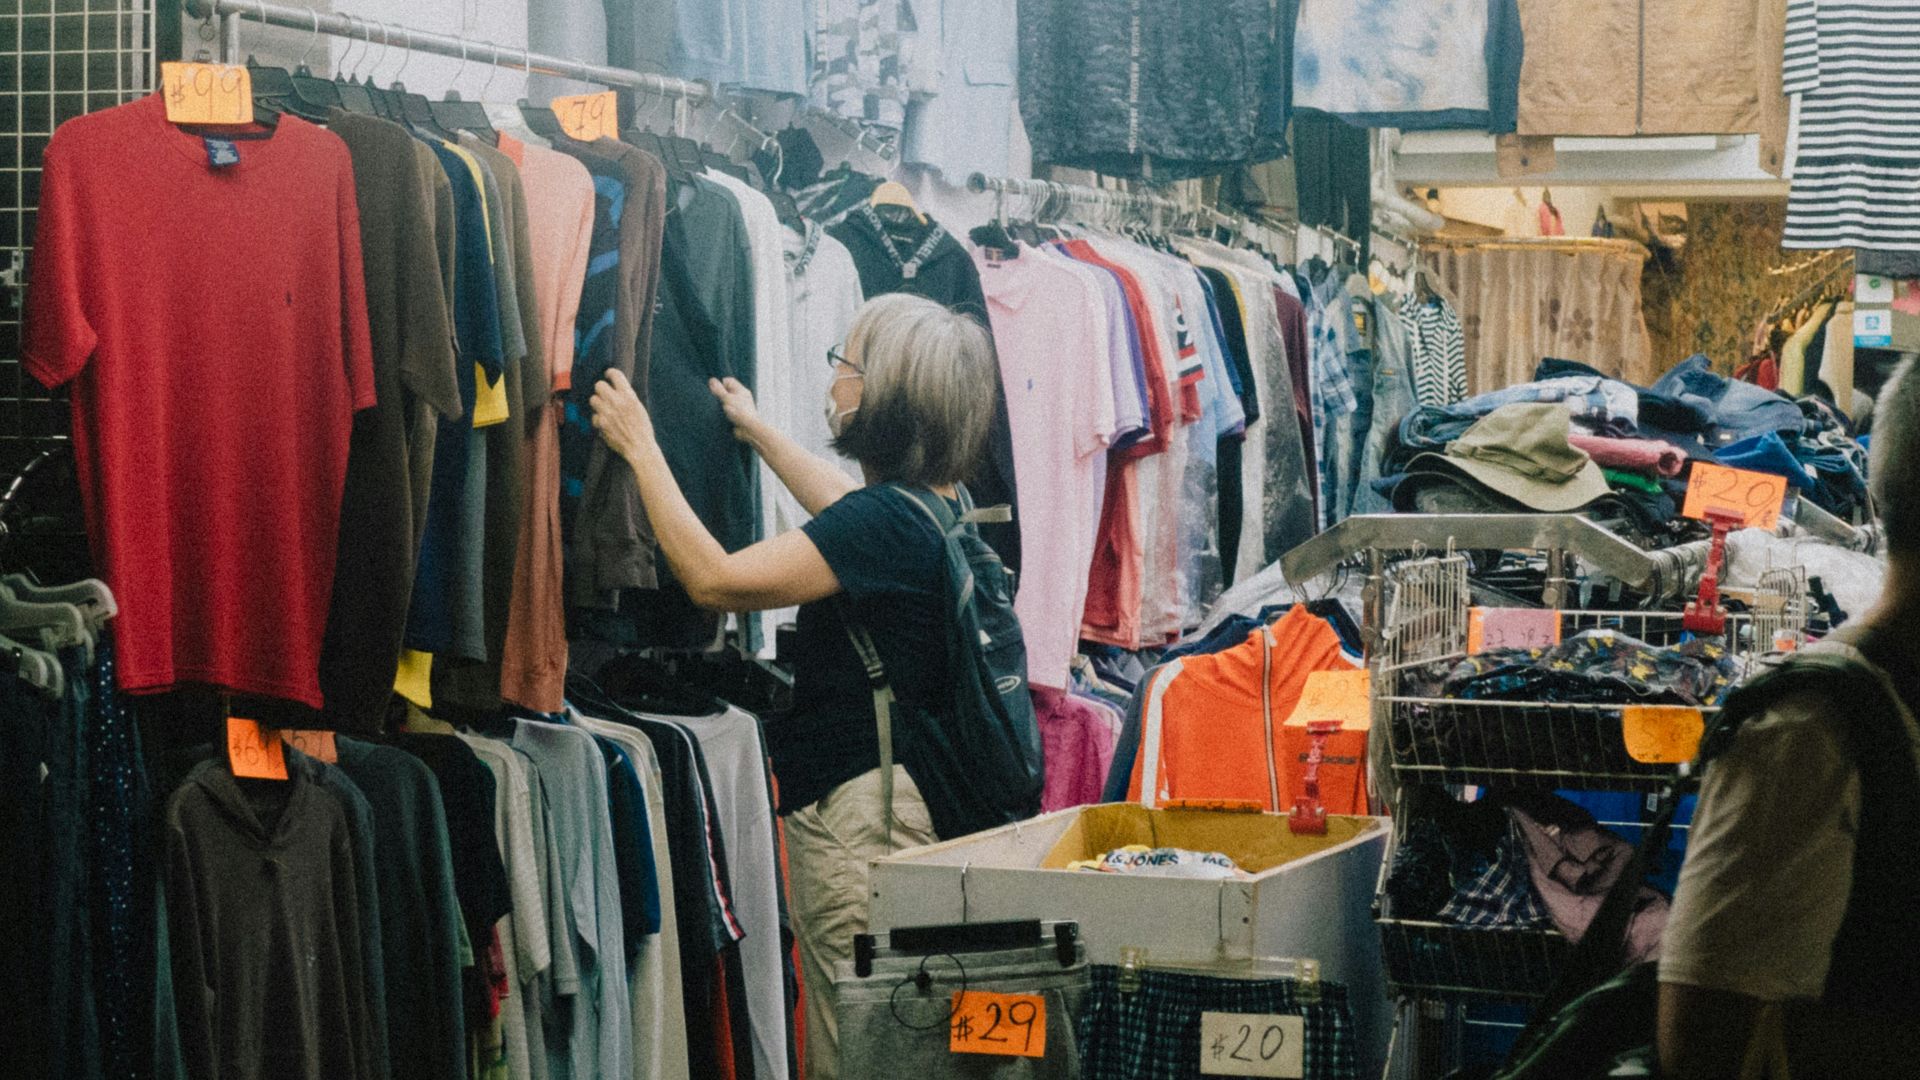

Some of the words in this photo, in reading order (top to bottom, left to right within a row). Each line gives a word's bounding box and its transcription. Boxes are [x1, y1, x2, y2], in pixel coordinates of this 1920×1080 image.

[171, 67, 243, 121] $99
[951, 1001, 1037, 1052] $29
[1211, 1024, 1284, 1062] $20
